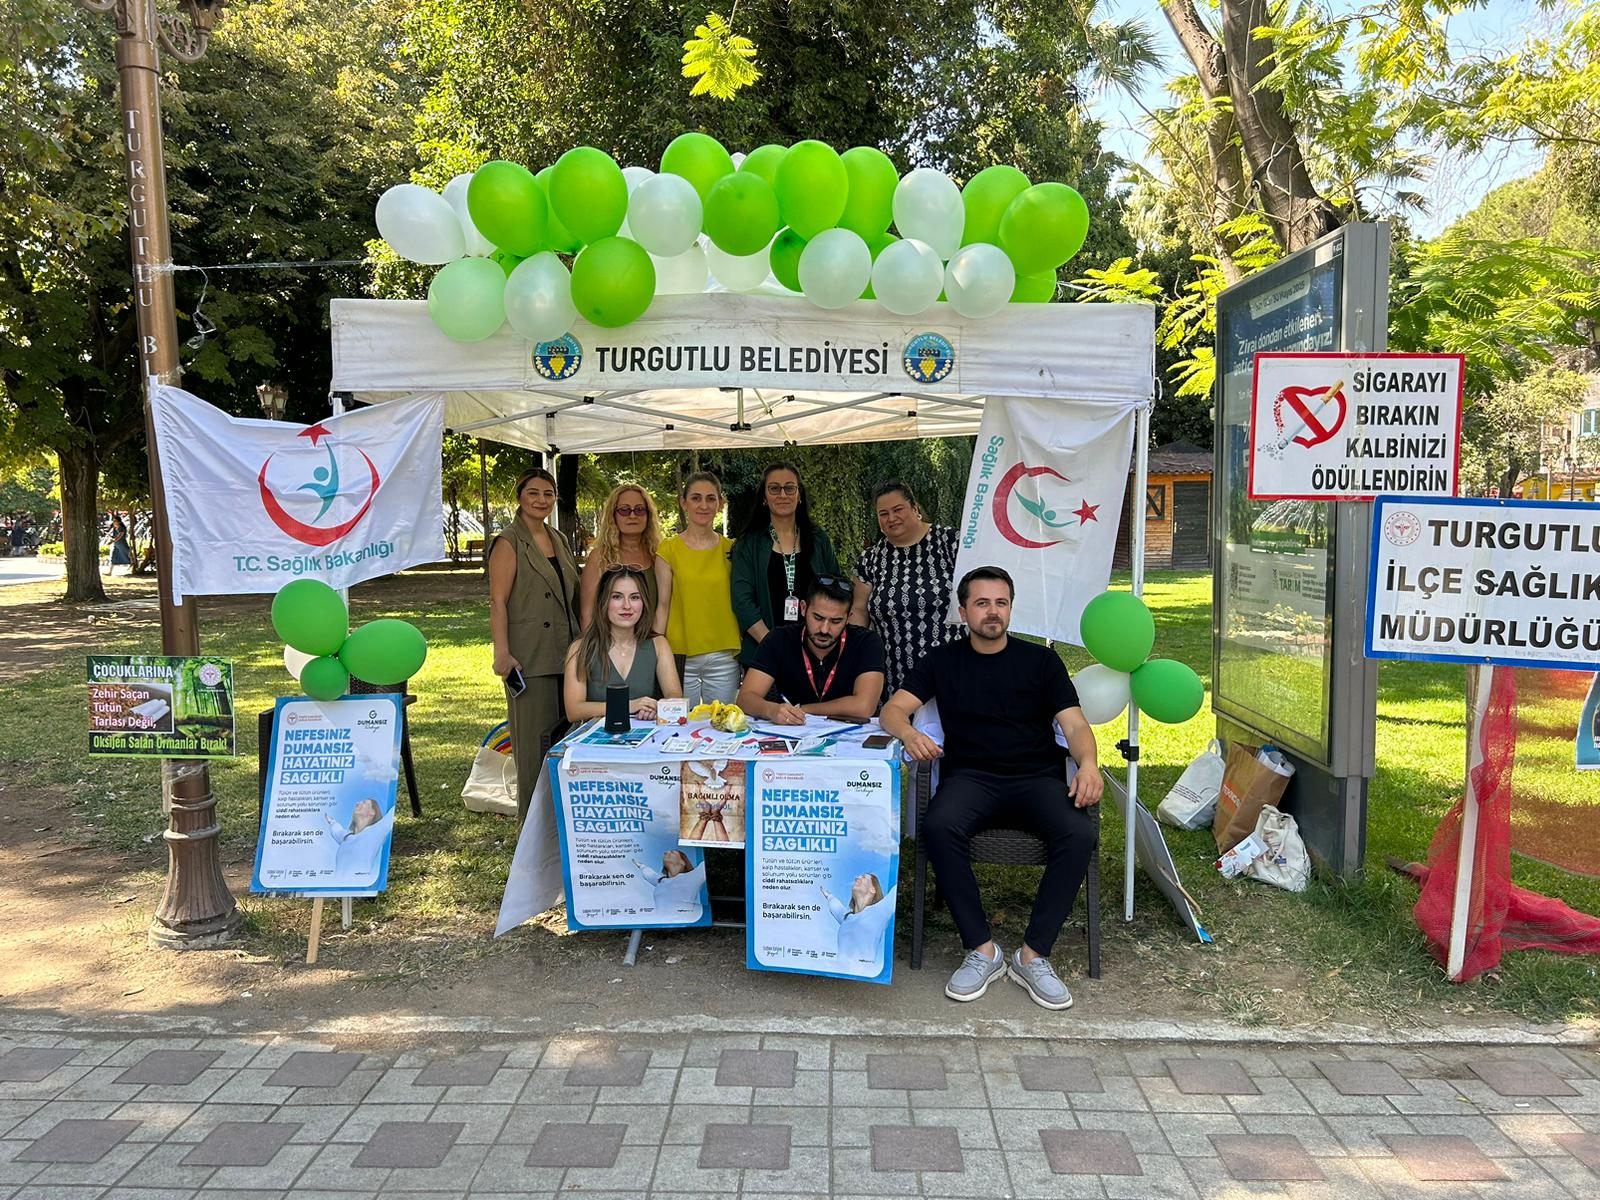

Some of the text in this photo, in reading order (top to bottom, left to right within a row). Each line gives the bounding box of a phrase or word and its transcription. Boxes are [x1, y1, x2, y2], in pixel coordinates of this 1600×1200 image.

[595, 340, 889, 375] TURGUTLU BELEDİYESİ
[1352, 367, 1447, 393] SİGARAYI
[1356, 405, 1440, 426] BIRAKIN
[1346, 433, 1447, 459] KALBİNİZİ
[1311, 464, 1448, 492] ÖDÜLLENDİRİN
[962, 434, 1004, 549] Sağlık Bakanlığı
[266, 553, 322, 575] Sağlık
[325, 540, 394, 570] Bakanlığı
[1386, 559, 1600, 601] İLÇE SAĞLIK
[93, 664, 174, 678] ÇOCUKLARINA
[92, 688, 149, 701] Zehir Saçan
[283, 743, 354, 754] DUMANSIZ
[283, 756, 353, 768] HAYATINIZ
[569, 794, 648, 807] DUMANSIZ
[573, 807, 651, 820] HAYATINIZ
[762, 804, 844, 819] DUMANSIZ
[764, 820, 846, 835] HAYATINIZ
[762, 902, 796, 910] Bırakarak
[762, 911, 812, 920] başarabilirsin.
